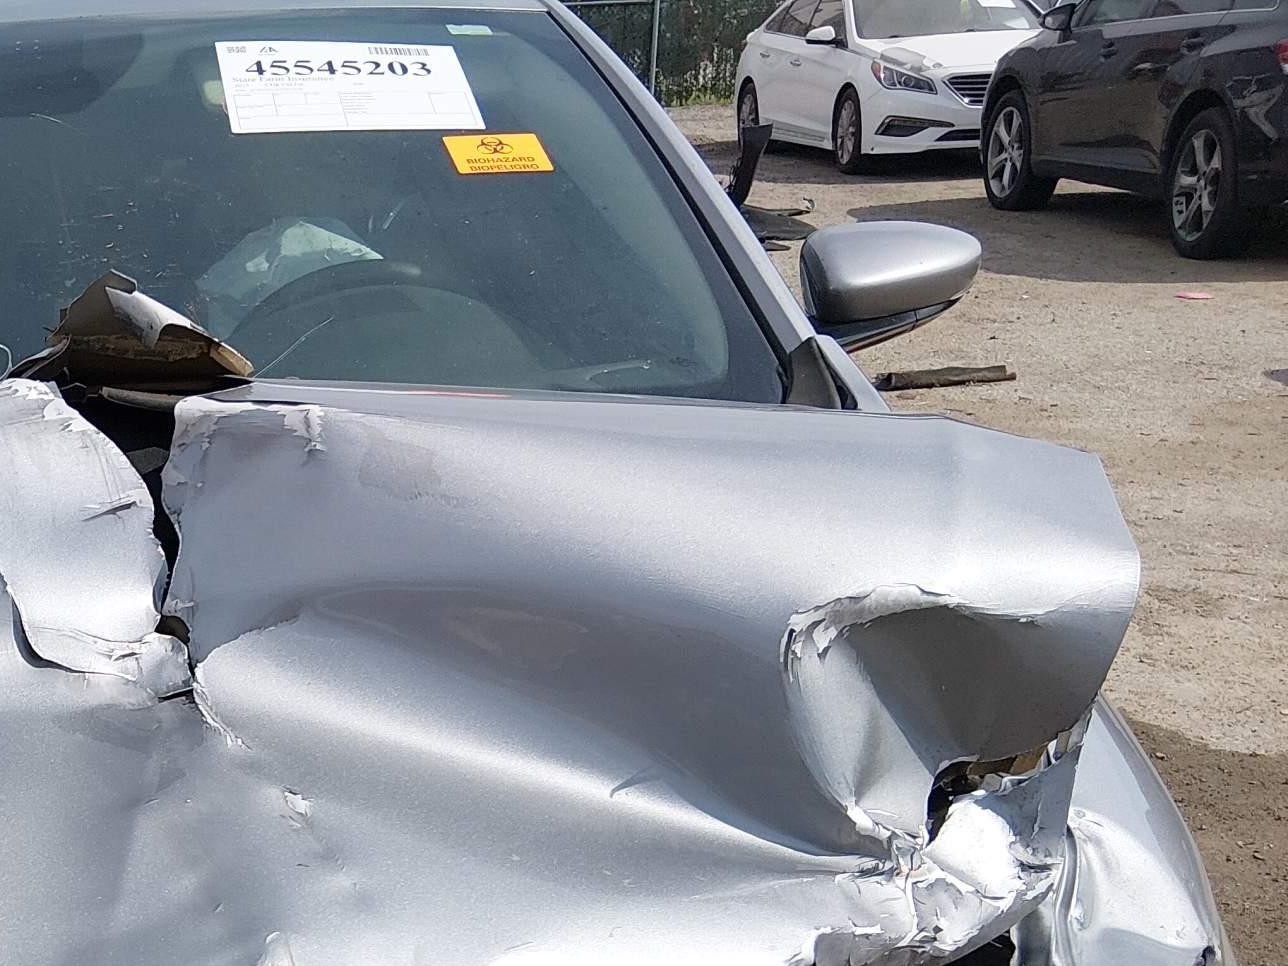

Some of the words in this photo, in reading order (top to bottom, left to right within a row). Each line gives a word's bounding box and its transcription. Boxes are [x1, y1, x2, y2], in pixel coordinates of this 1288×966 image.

[245, 60, 432, 76] 45545203
[466, 156, 535, 165] BIOHAZARD
[470, 164, 539, 173] BIOPELIGRO
